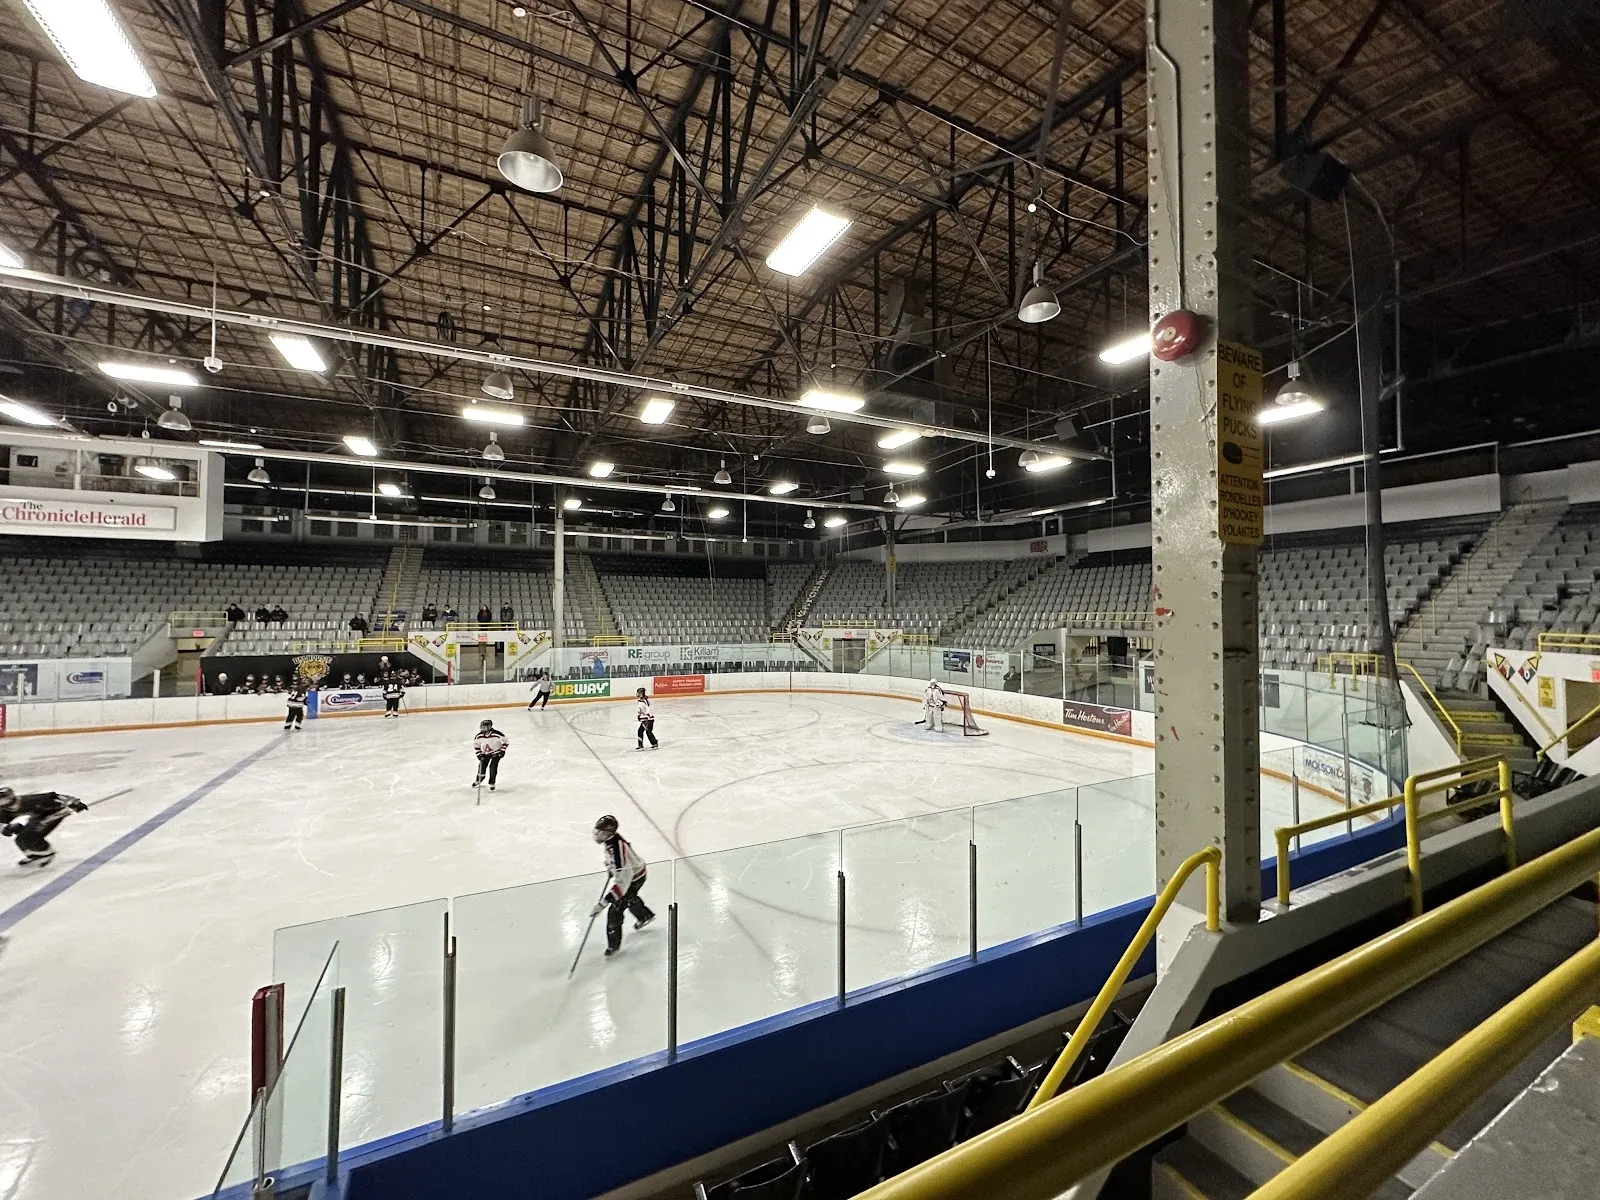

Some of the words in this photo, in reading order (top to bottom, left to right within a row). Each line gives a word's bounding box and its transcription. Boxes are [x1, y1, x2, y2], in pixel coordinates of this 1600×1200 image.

[1217, 343, 1261, 373] BEWARE
[1232, 371, 1247, 389] OF
[1222, 392, 1258, 415] FLYING
[1223, 416, 1258, 440] PUCKS
[20, 501, 43, 510] The
[2, 506, 146, 526] ChronicleHerald
[1222, 524, 1260, 539] VOLANTES
[644, 650, 671, 660] group
[1064, 708, 1077, 720] Tim
[1077, 710, 1105, 725] Hortons
[1305, 758, 1336, 777] MOLSON
